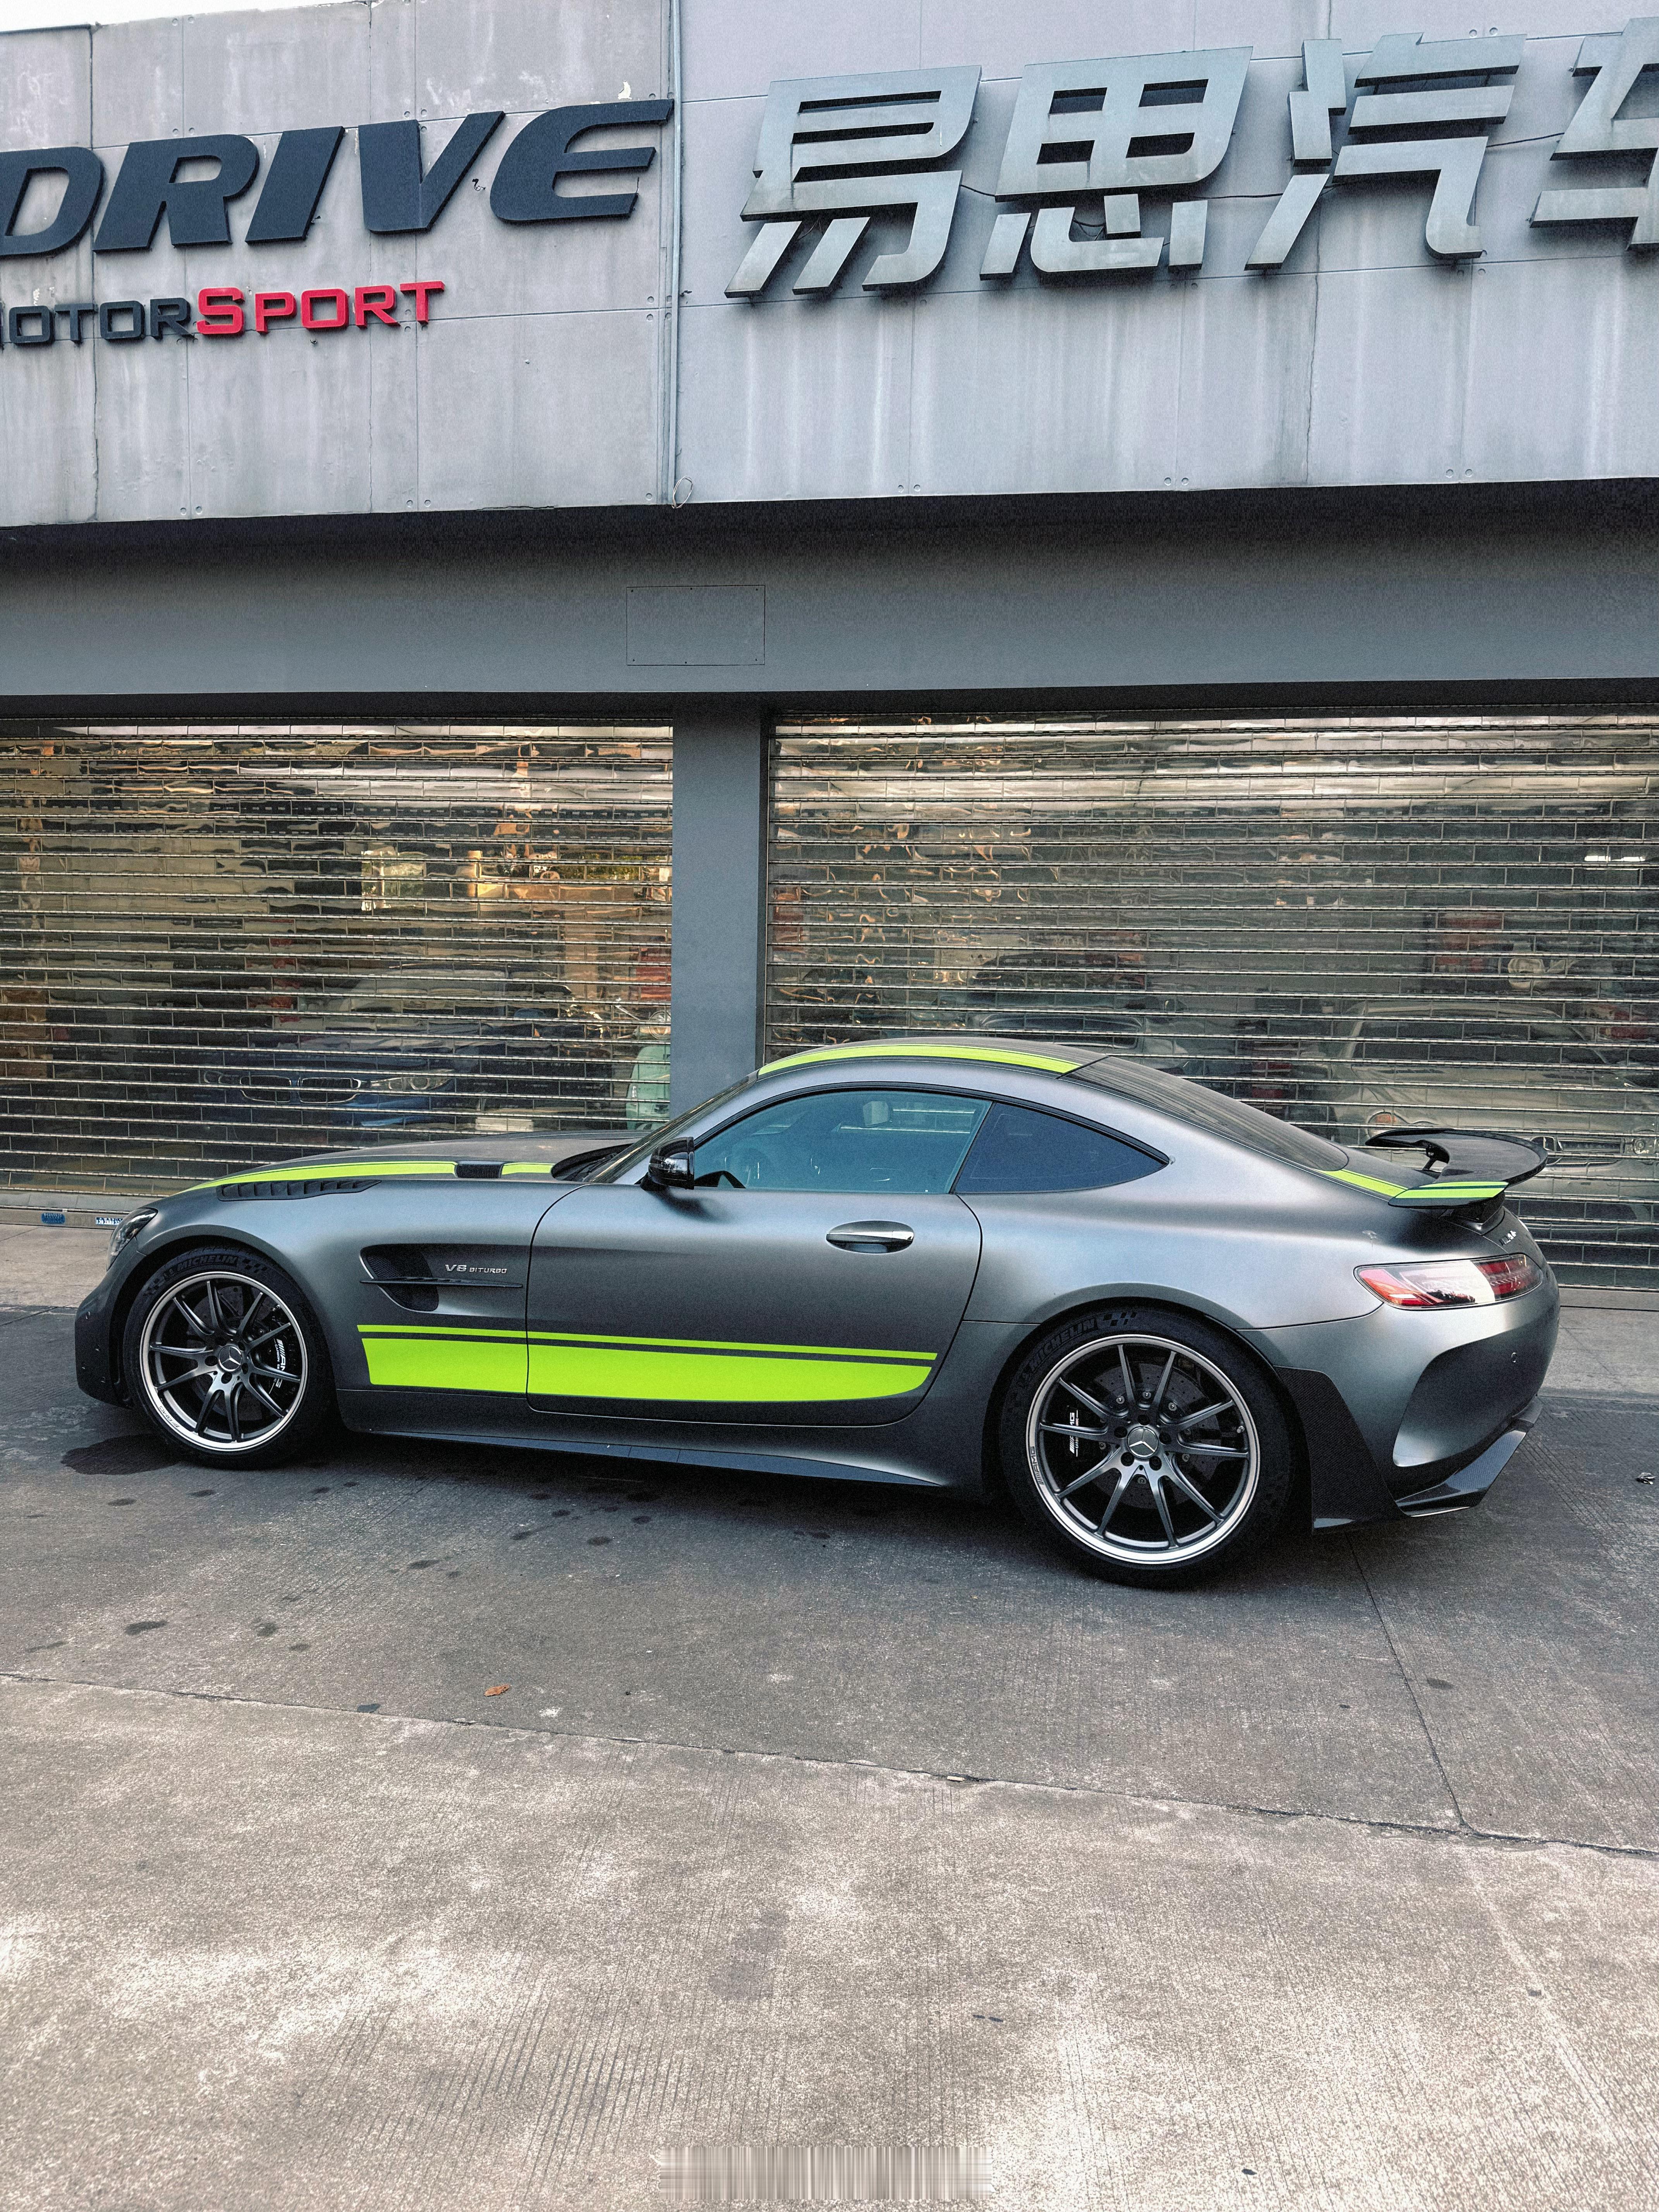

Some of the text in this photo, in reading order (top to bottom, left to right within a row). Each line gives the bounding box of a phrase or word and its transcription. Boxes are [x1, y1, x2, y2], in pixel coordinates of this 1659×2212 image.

[0, 99, 674, 256] DRIVE
[0, 280, 445, 347] OTORSPORT
[177, 1255, 238, 1271] MICHELIN
[1029, 1317, 1096, 1372] MICHELIN
